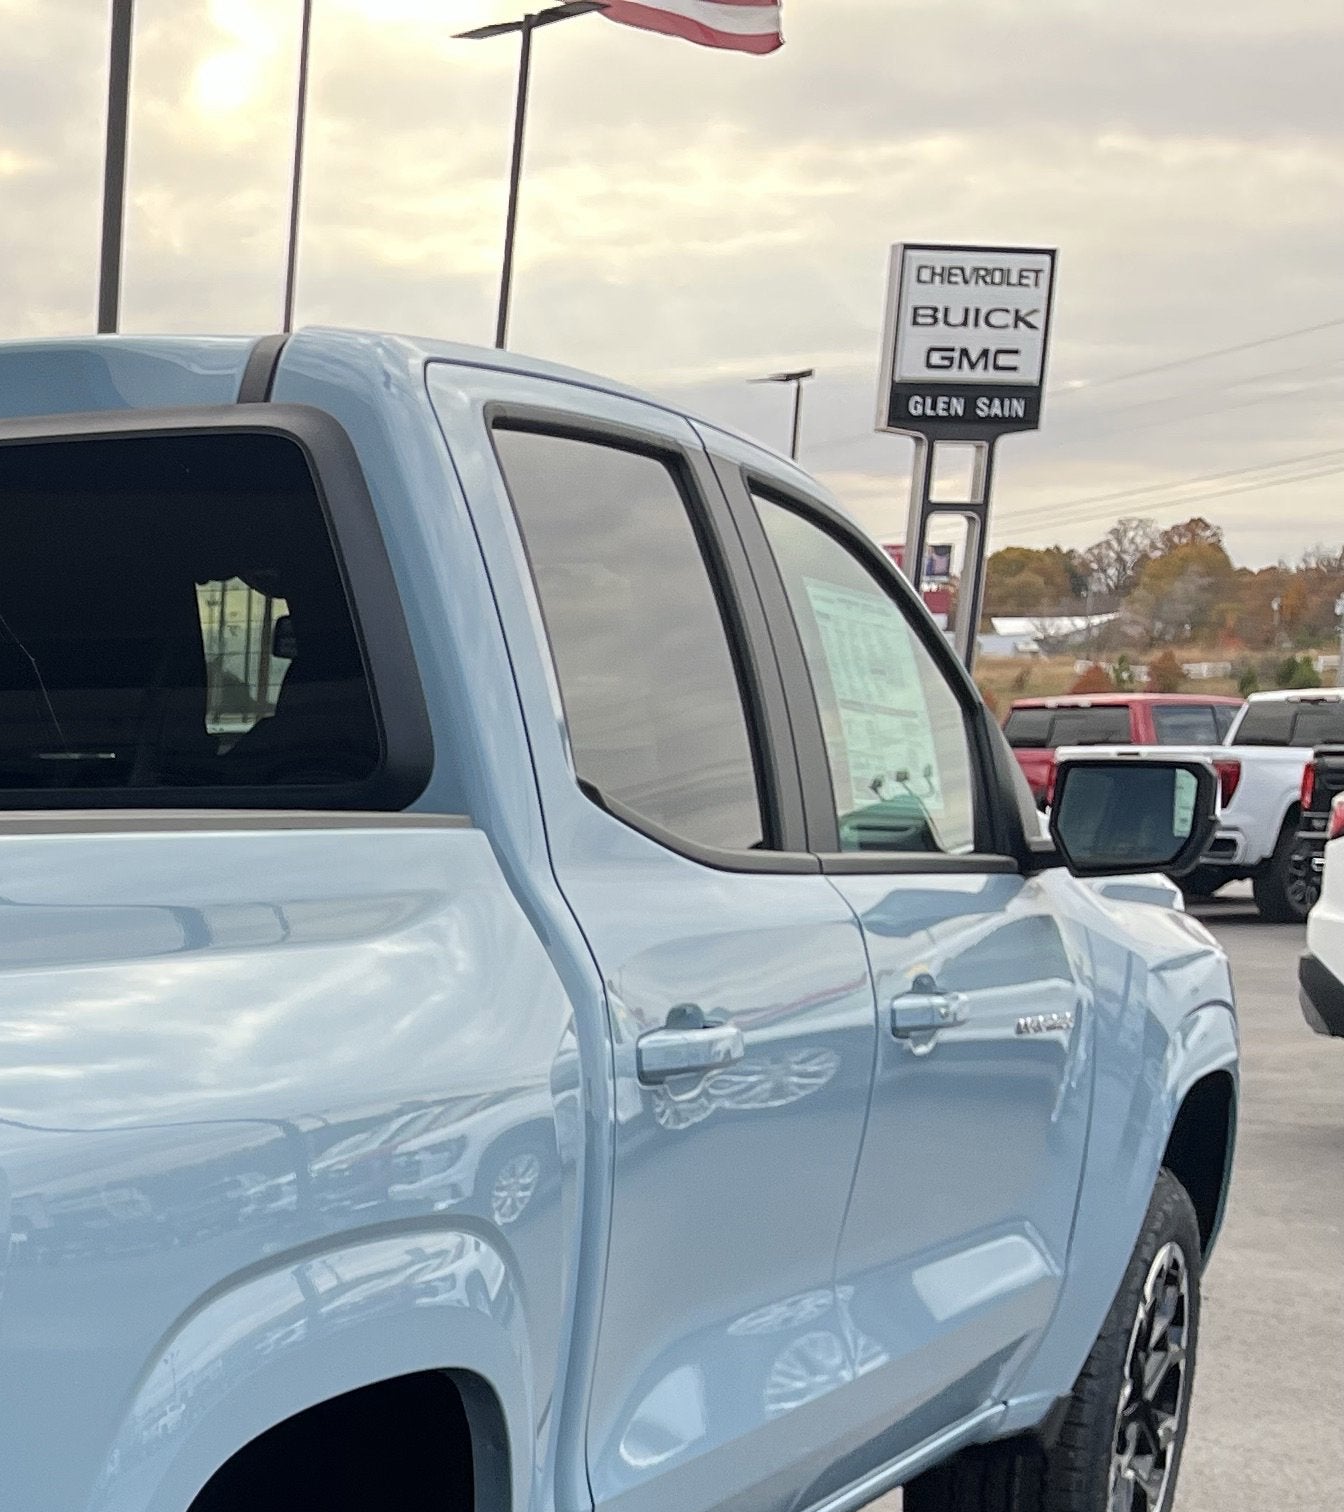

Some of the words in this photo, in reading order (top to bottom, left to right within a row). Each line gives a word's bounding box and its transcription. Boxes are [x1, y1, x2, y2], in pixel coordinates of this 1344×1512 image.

[916, 264, 1044, 288] CHEVROLET
[911, 305, 1040, 330] BUICK
[924, 346, 1020, 372] GMC
[908, 395, 965, 417] GLEN
[975, 396, 1026, 418] SAIN
